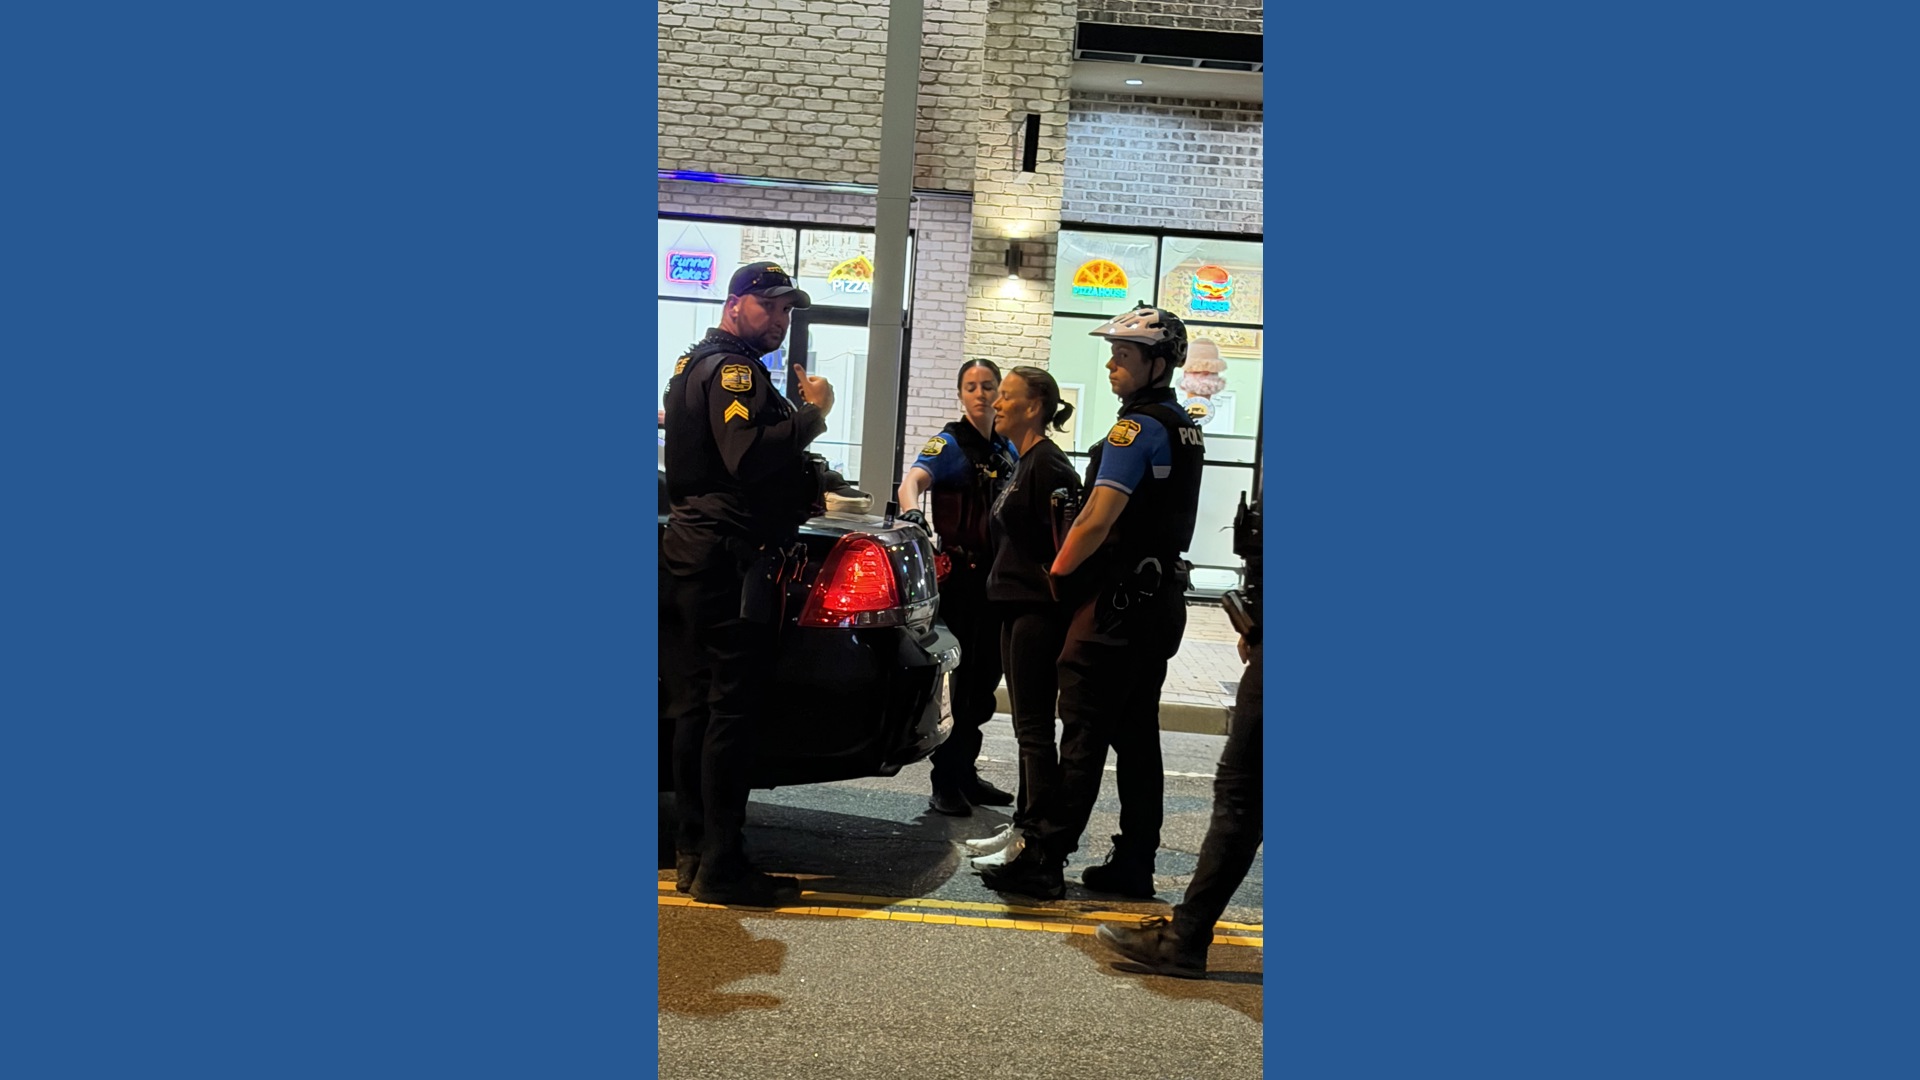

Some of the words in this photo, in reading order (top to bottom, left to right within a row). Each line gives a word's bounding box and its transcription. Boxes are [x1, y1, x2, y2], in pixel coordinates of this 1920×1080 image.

[670, 254, 713, 268] Funnel
[672, 266, 710, 280] Cakes
[832, 280, 870, 293] PIZZA
[1191, 299, 1230, 312] BURGER
